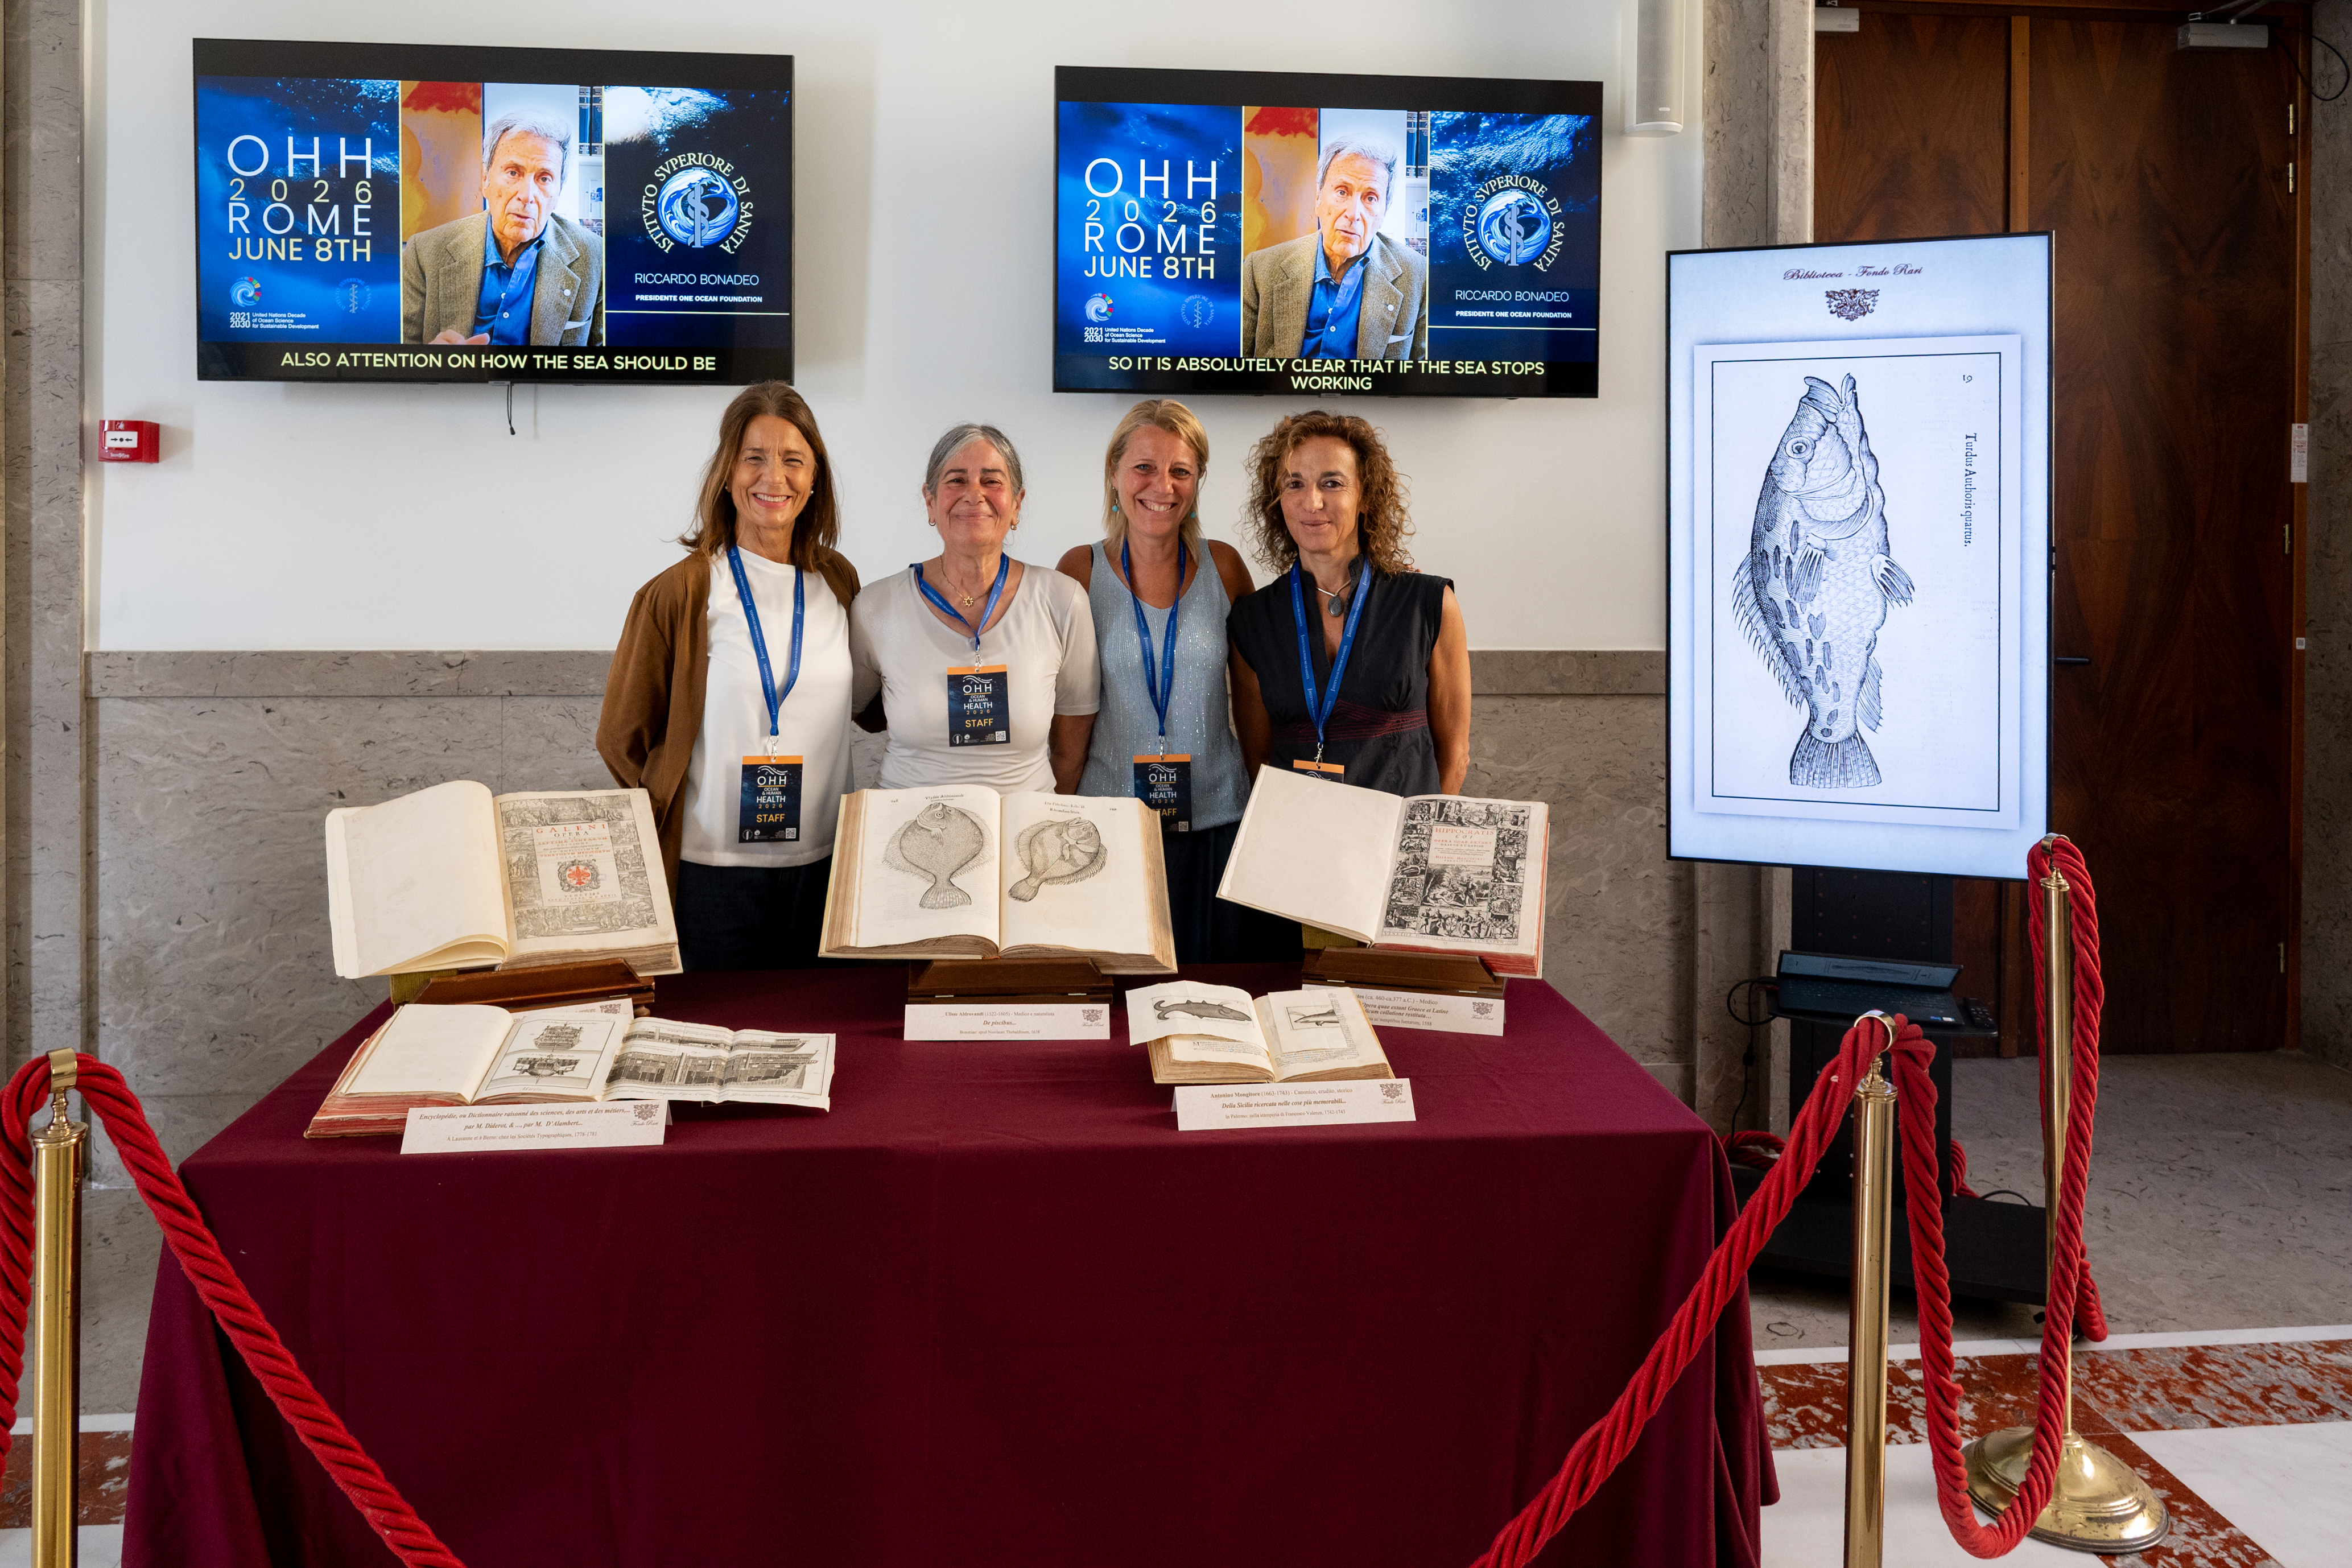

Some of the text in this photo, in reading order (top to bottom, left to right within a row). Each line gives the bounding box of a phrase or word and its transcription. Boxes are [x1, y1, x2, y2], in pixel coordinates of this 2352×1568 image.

[228, 135, 371, 179] OHH
[1084, 158, 1216, 200] OHH
[229, 178, 372, 203] 2026
[642, 152, 753, 254] ISTITVTO SVPERIORE DI SANITÀ
[1086, 199, 1216, 223] 2026
[229, 203, 371, 236] ROME
[1463, 175, 1565, 272] ISTITVTO SVPERIORE DI SANITÀ
[1085, 222, 1215, 254] ROME
[228, 237, 370, 262] JUNE 8TH
[1084, 256, 1214, 279] JUNE 8TH
[1783, 269, 1843, 280] Biblioteca
[1855, 265, 1890, 277] Fondo
[1893, 263, 1923, 275] Rari
[635, 273, 759, 286] RICCARDO BONADEO
[1455, 290, 1569, 302] RICCARDO BONADEO
[280, 352, 716, 370] ALSO ATTENTION ON HOW THE SEA SHOULD BE
[1108, 357, 1545, 375] SO IT IS ABSOLUTELY CLEAR THAT IF THE SEA STOPS
[1291, 376, 1372, 390] WORKING
[1962, 375, 1973, 383] 19
[1961, 432, 1977, 547] Turdus Authoris quartus.
[963, 684, 992, 694] OHH
[965, 719, 993, 728] STAFF
[757, 775, 787, 785] OHH
[1149, 773, 1176, 782] OHH
[756, 814, 785, 823] STAFF
[536, 824, 605, 833] GALENI
